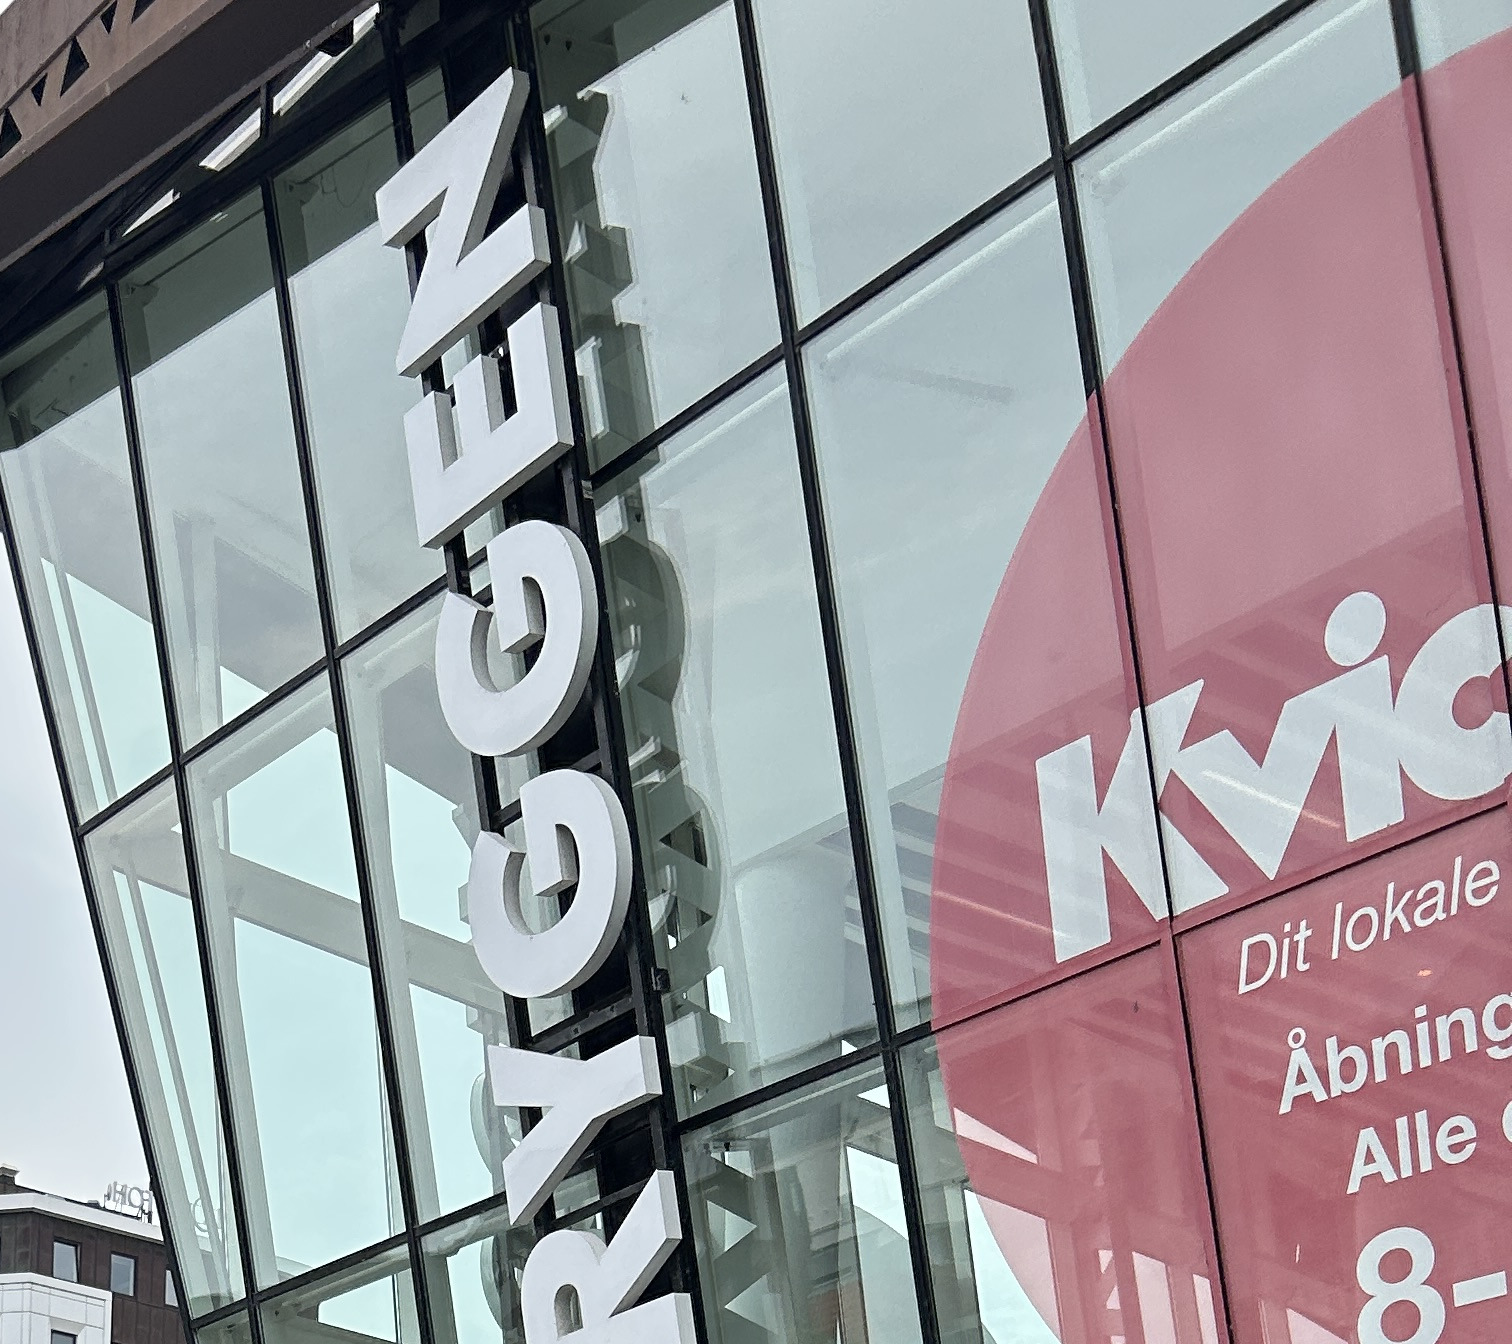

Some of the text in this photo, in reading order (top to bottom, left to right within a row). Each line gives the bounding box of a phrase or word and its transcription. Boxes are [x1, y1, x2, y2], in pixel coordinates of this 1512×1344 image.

[1237, 855, 1500, 995] Dit lokale
[1346, 1108, 1478, 1195] Alle
